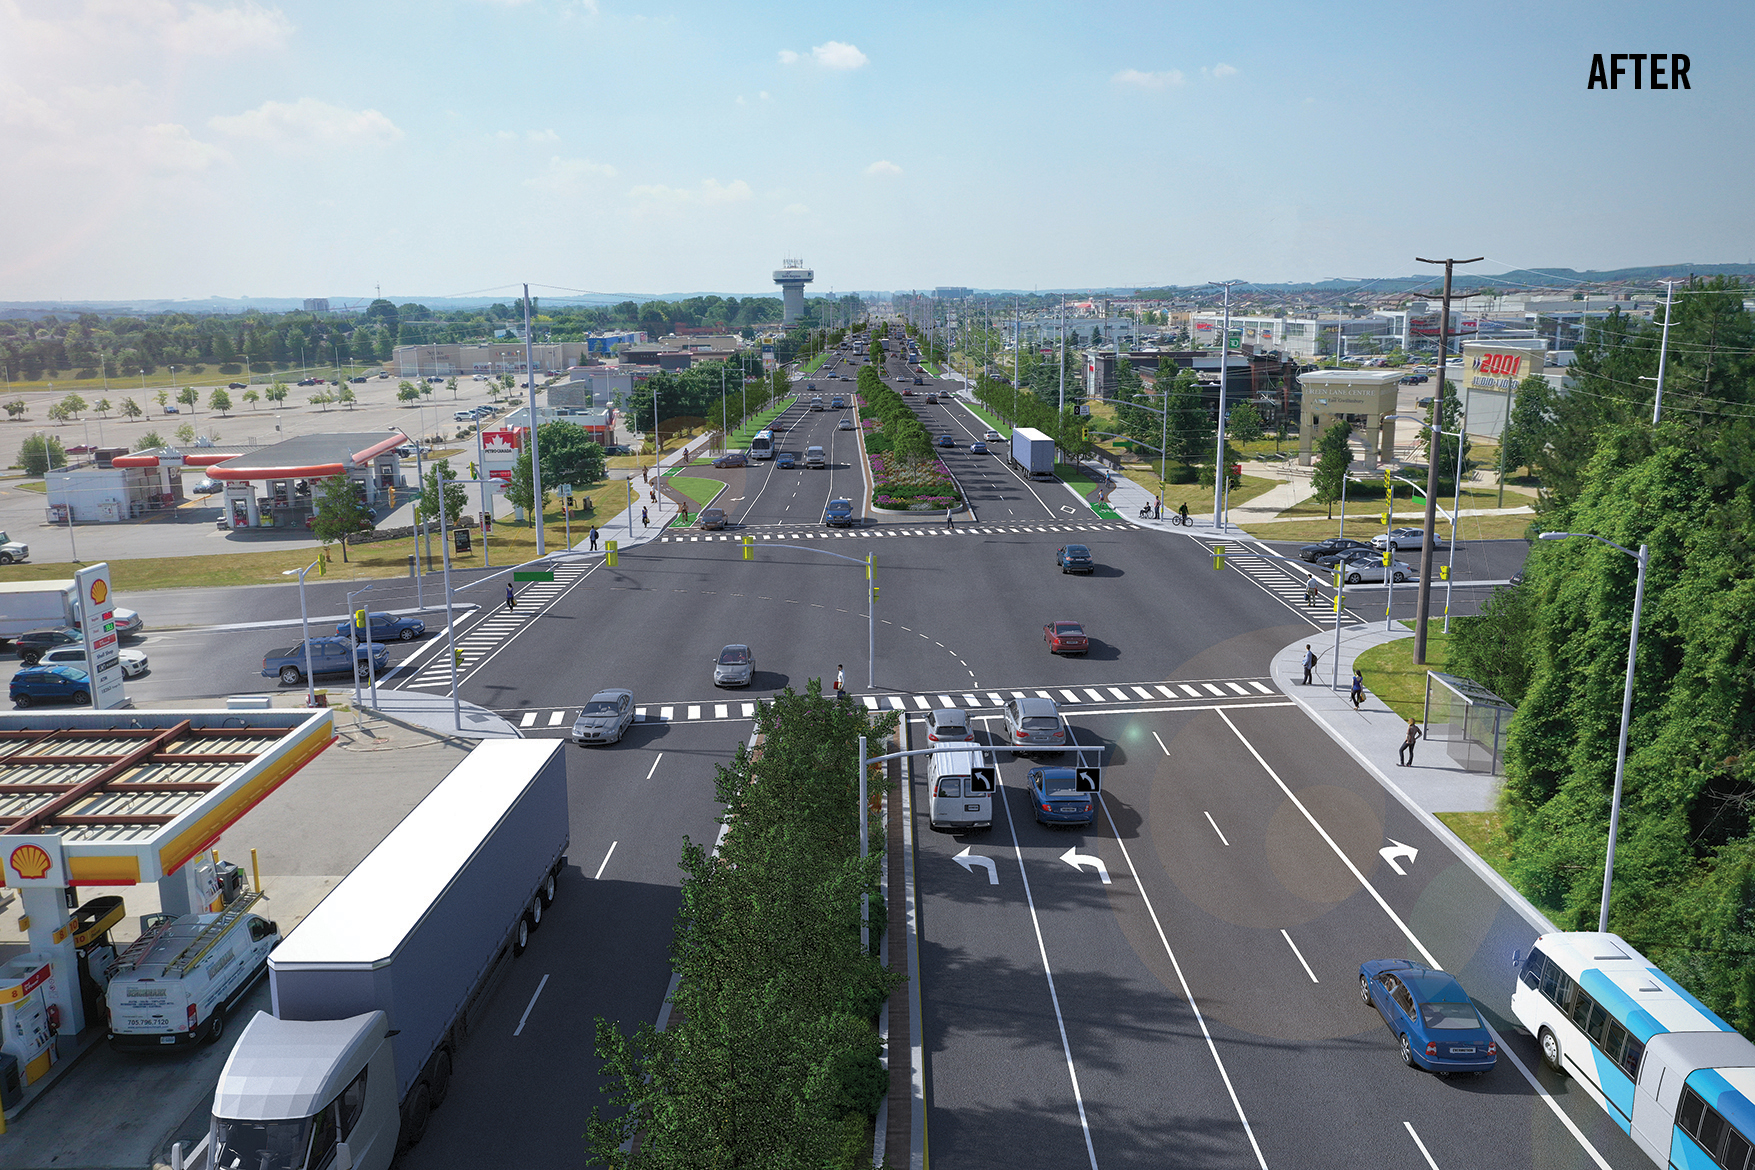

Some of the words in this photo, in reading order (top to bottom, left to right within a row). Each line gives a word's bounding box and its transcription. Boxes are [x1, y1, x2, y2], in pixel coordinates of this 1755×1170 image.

[1480, 353, 1521, 376] 2001
[69, 919, 78, 931] 10
[75, 935, 86, 944] 10
[12, 990, 18, 998] 8
